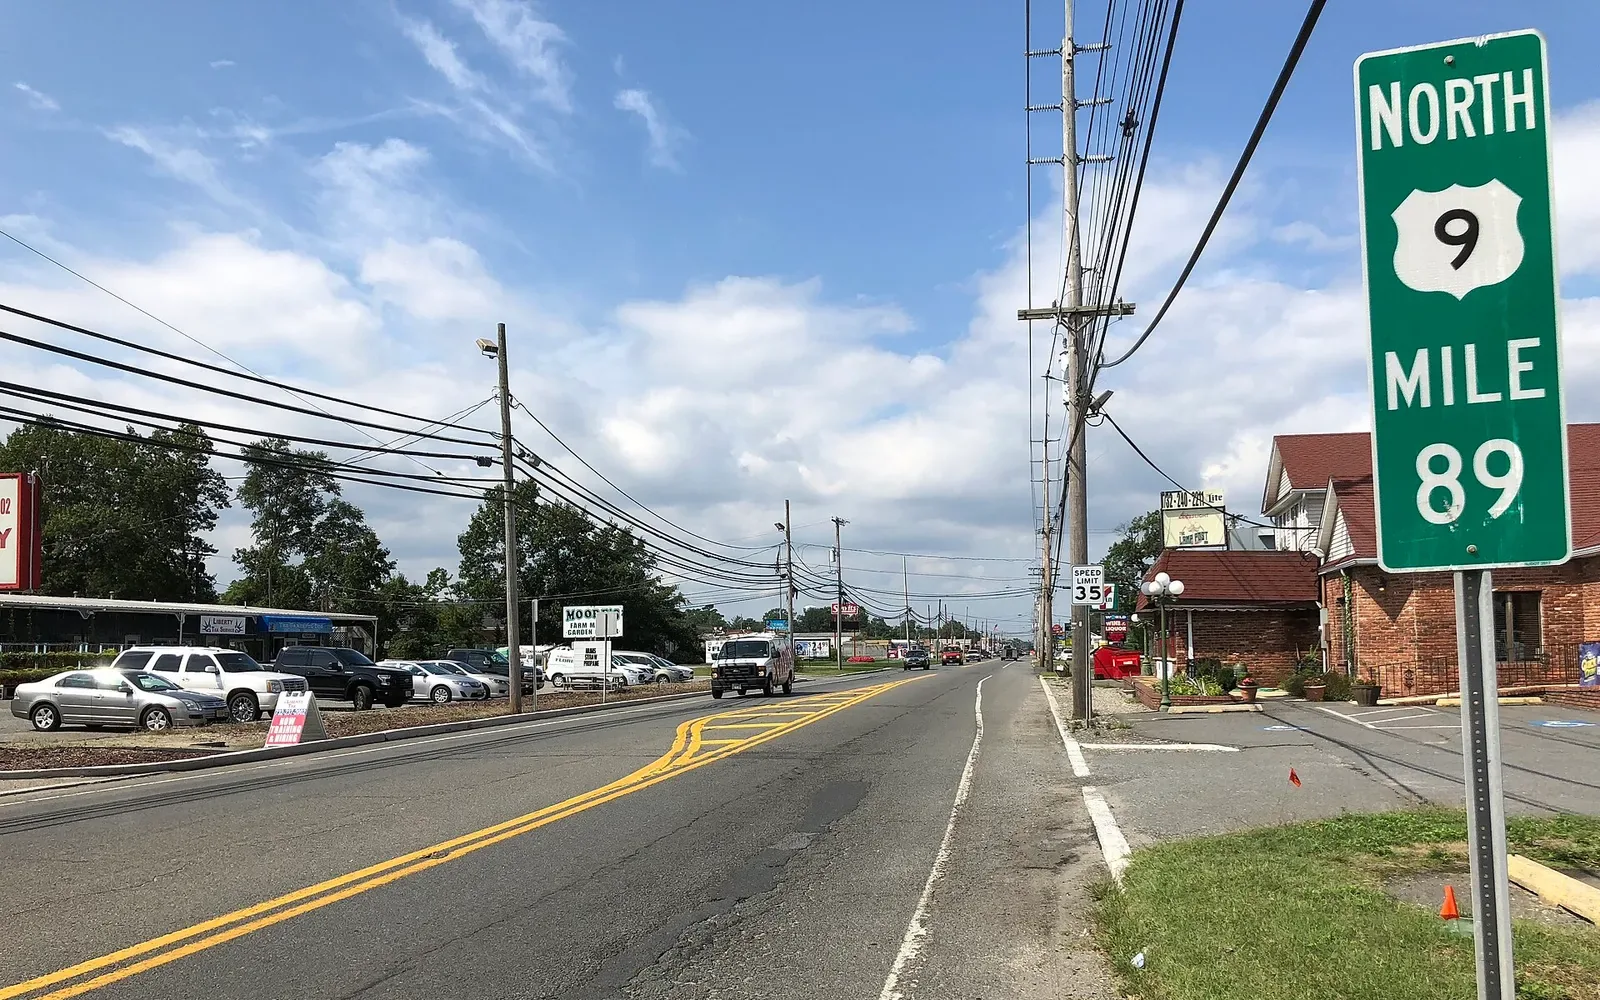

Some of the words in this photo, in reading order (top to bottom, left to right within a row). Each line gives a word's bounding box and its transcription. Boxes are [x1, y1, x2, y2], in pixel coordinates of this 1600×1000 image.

[1369, 68, 1535, 150] NORTH
[1434, 208, 1479, 270] 9
[1385, 337, 1546, 410] MILE
[1415, 438, 1524, 524] 89
[1208, 494, 1223, 503] Lite
[1075, 586, 1101, 600] 35
[213, 617, 233, 625] LIBERTY
[279, 717, 296, 726] NOW
[270, 726, 303, 734] TRAINING
[275, 734, 297, 743] HIRING
